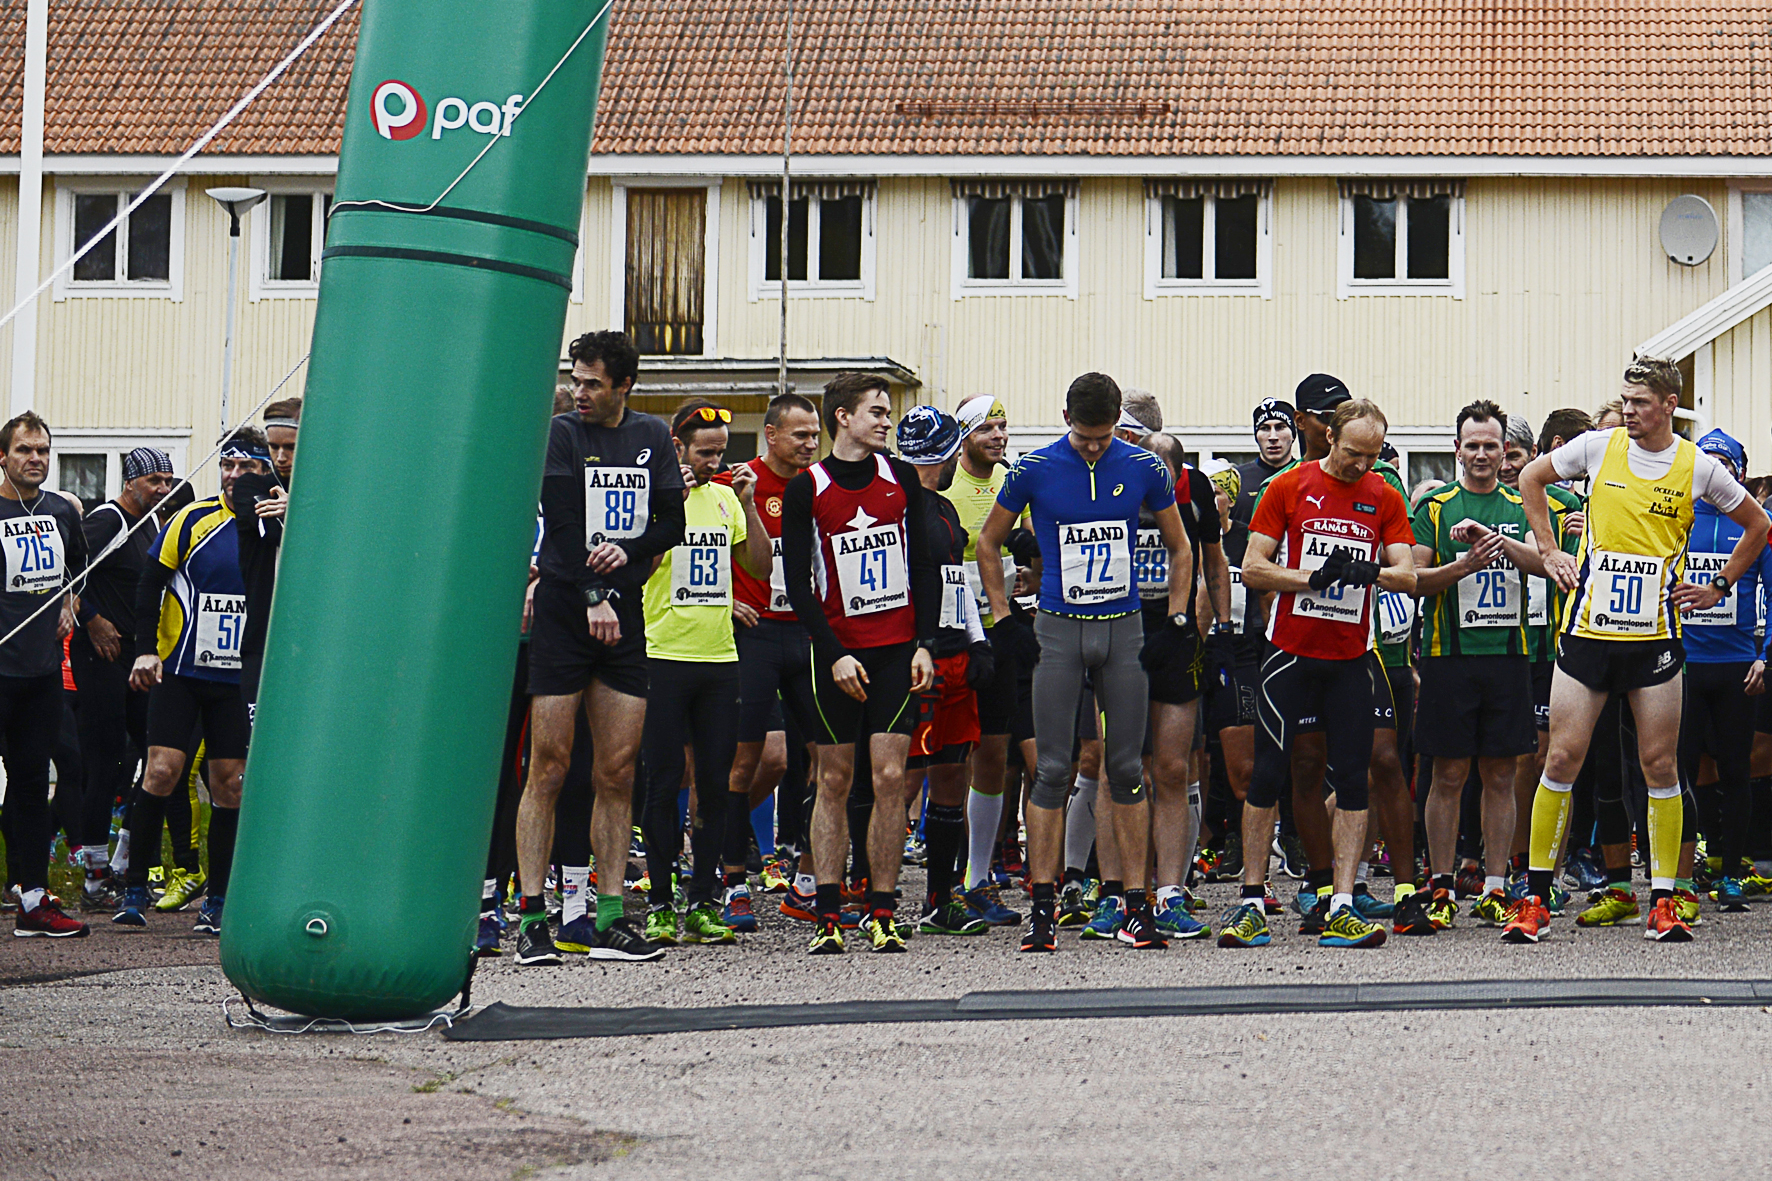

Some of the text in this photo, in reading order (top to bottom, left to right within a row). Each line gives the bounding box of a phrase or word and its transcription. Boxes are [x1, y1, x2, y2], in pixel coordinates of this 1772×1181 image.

[431, 94, 523, 139] paf
[590, 469, 646, 489] ÅLAND
[4, 521, 55, 537] ÅLAND
[605, 490, 636, 531] 89
[16, 534, 54, 572] 215
[839, 531, 897, 555] ÅLAND
[1064, 526, 1123, 544] ÅLAND
[690, 549, 718, 586] 63
[860, 549, 887, 591] 47
[1081, 543, 1113, 583] 72
[1598, 554, 1657, 575] ÅLAND
[1476, 571, 1506, 608] 26
[1609, 574, 1643, 614] 50
[217, 615, 241, 651] 51
